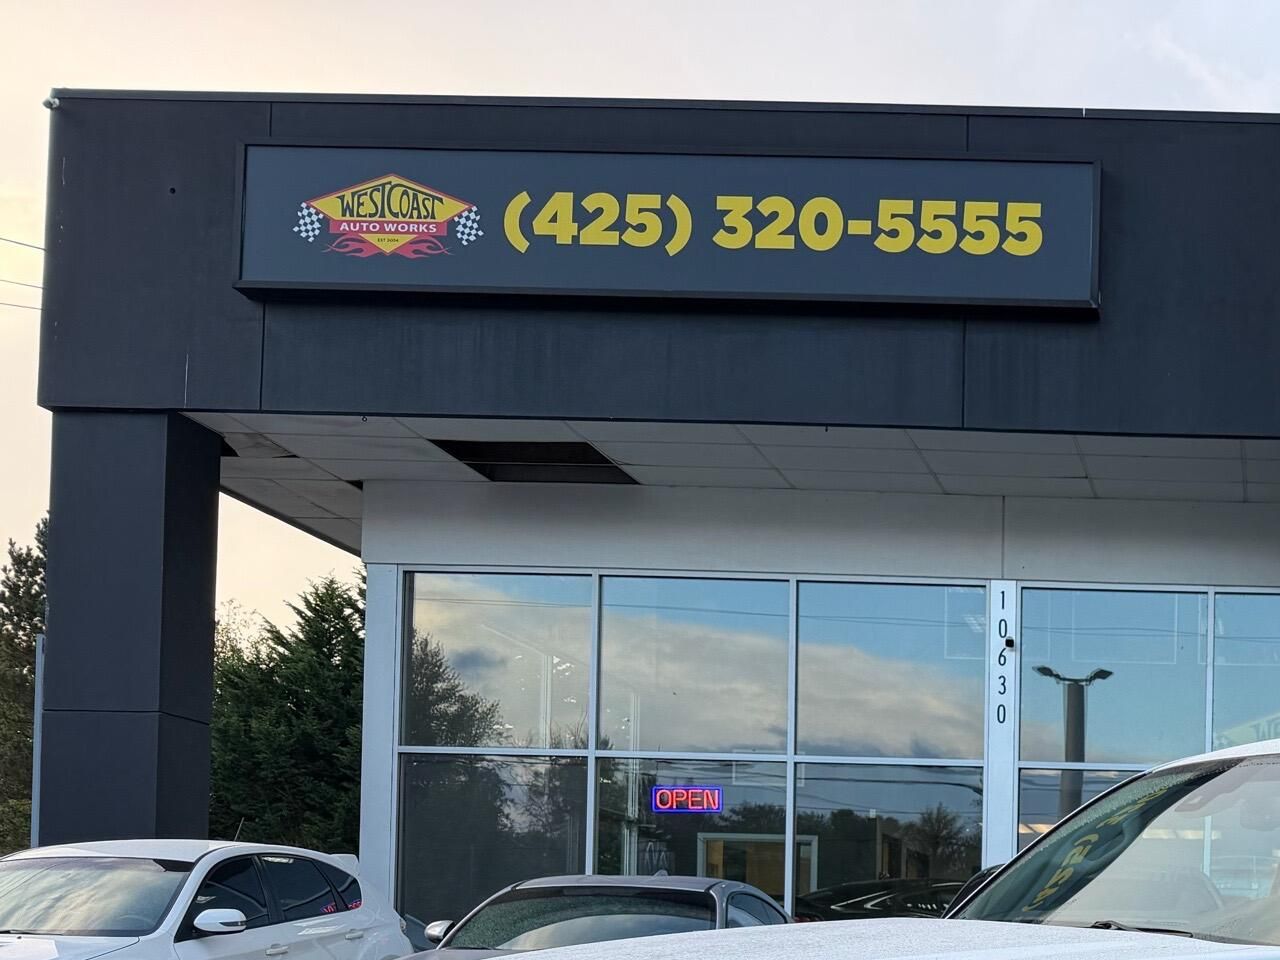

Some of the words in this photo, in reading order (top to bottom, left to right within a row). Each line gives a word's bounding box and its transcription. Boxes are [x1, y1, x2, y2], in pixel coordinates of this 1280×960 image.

[340, 222, 380, 232] AUTO
[384, 222, 437, 233] WORKS
[504, 190, 692, 257] (425)
[712, 195, 1043, 256] 320-5555
[996, 590, 1008, 724] 10630
[656, 789, 719, 809] OPEN
